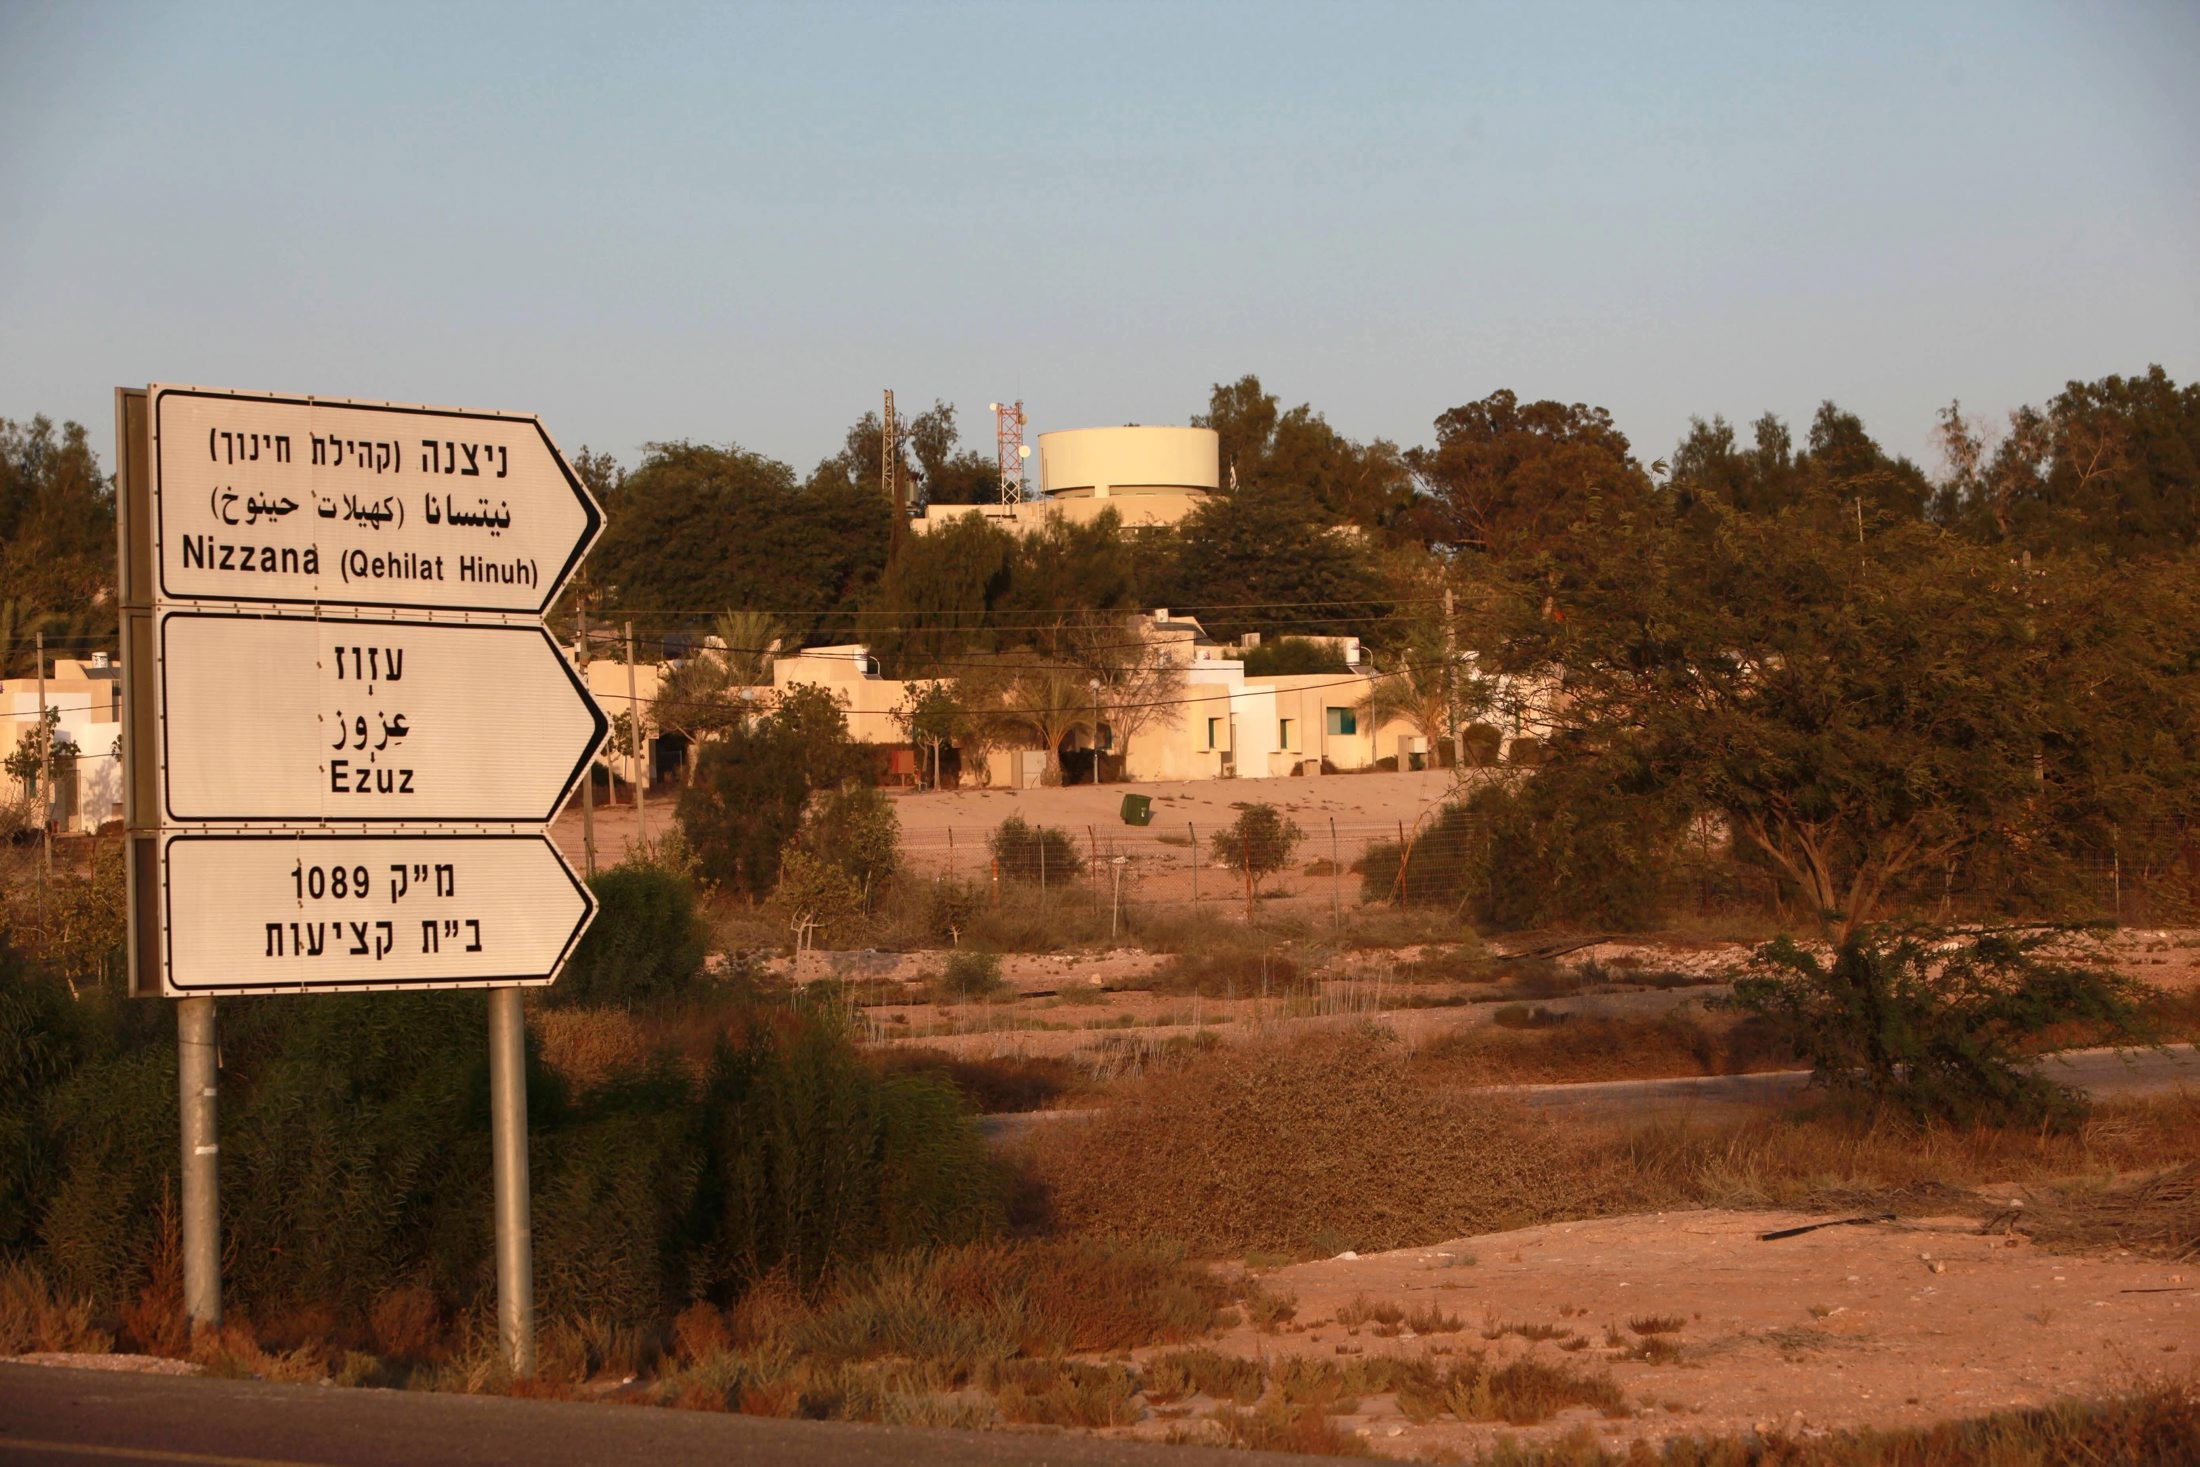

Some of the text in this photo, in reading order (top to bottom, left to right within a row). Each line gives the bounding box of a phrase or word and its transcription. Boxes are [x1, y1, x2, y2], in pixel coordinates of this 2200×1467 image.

[209, 427, 508, 479] ניצנה (קהילת חינוך)
[210, 485, 511, 537] نيتسانا (كهيلات حينوخ)
[182, 534, 538, 589] Nizzana (Qehilat Hinuh)
[334, 646, 403, 681] עזוז
[330, 760, 414, 794] Ezuz
[291, 865, 370, 900] 1089
[265, 920, 394, 961] קציעות
